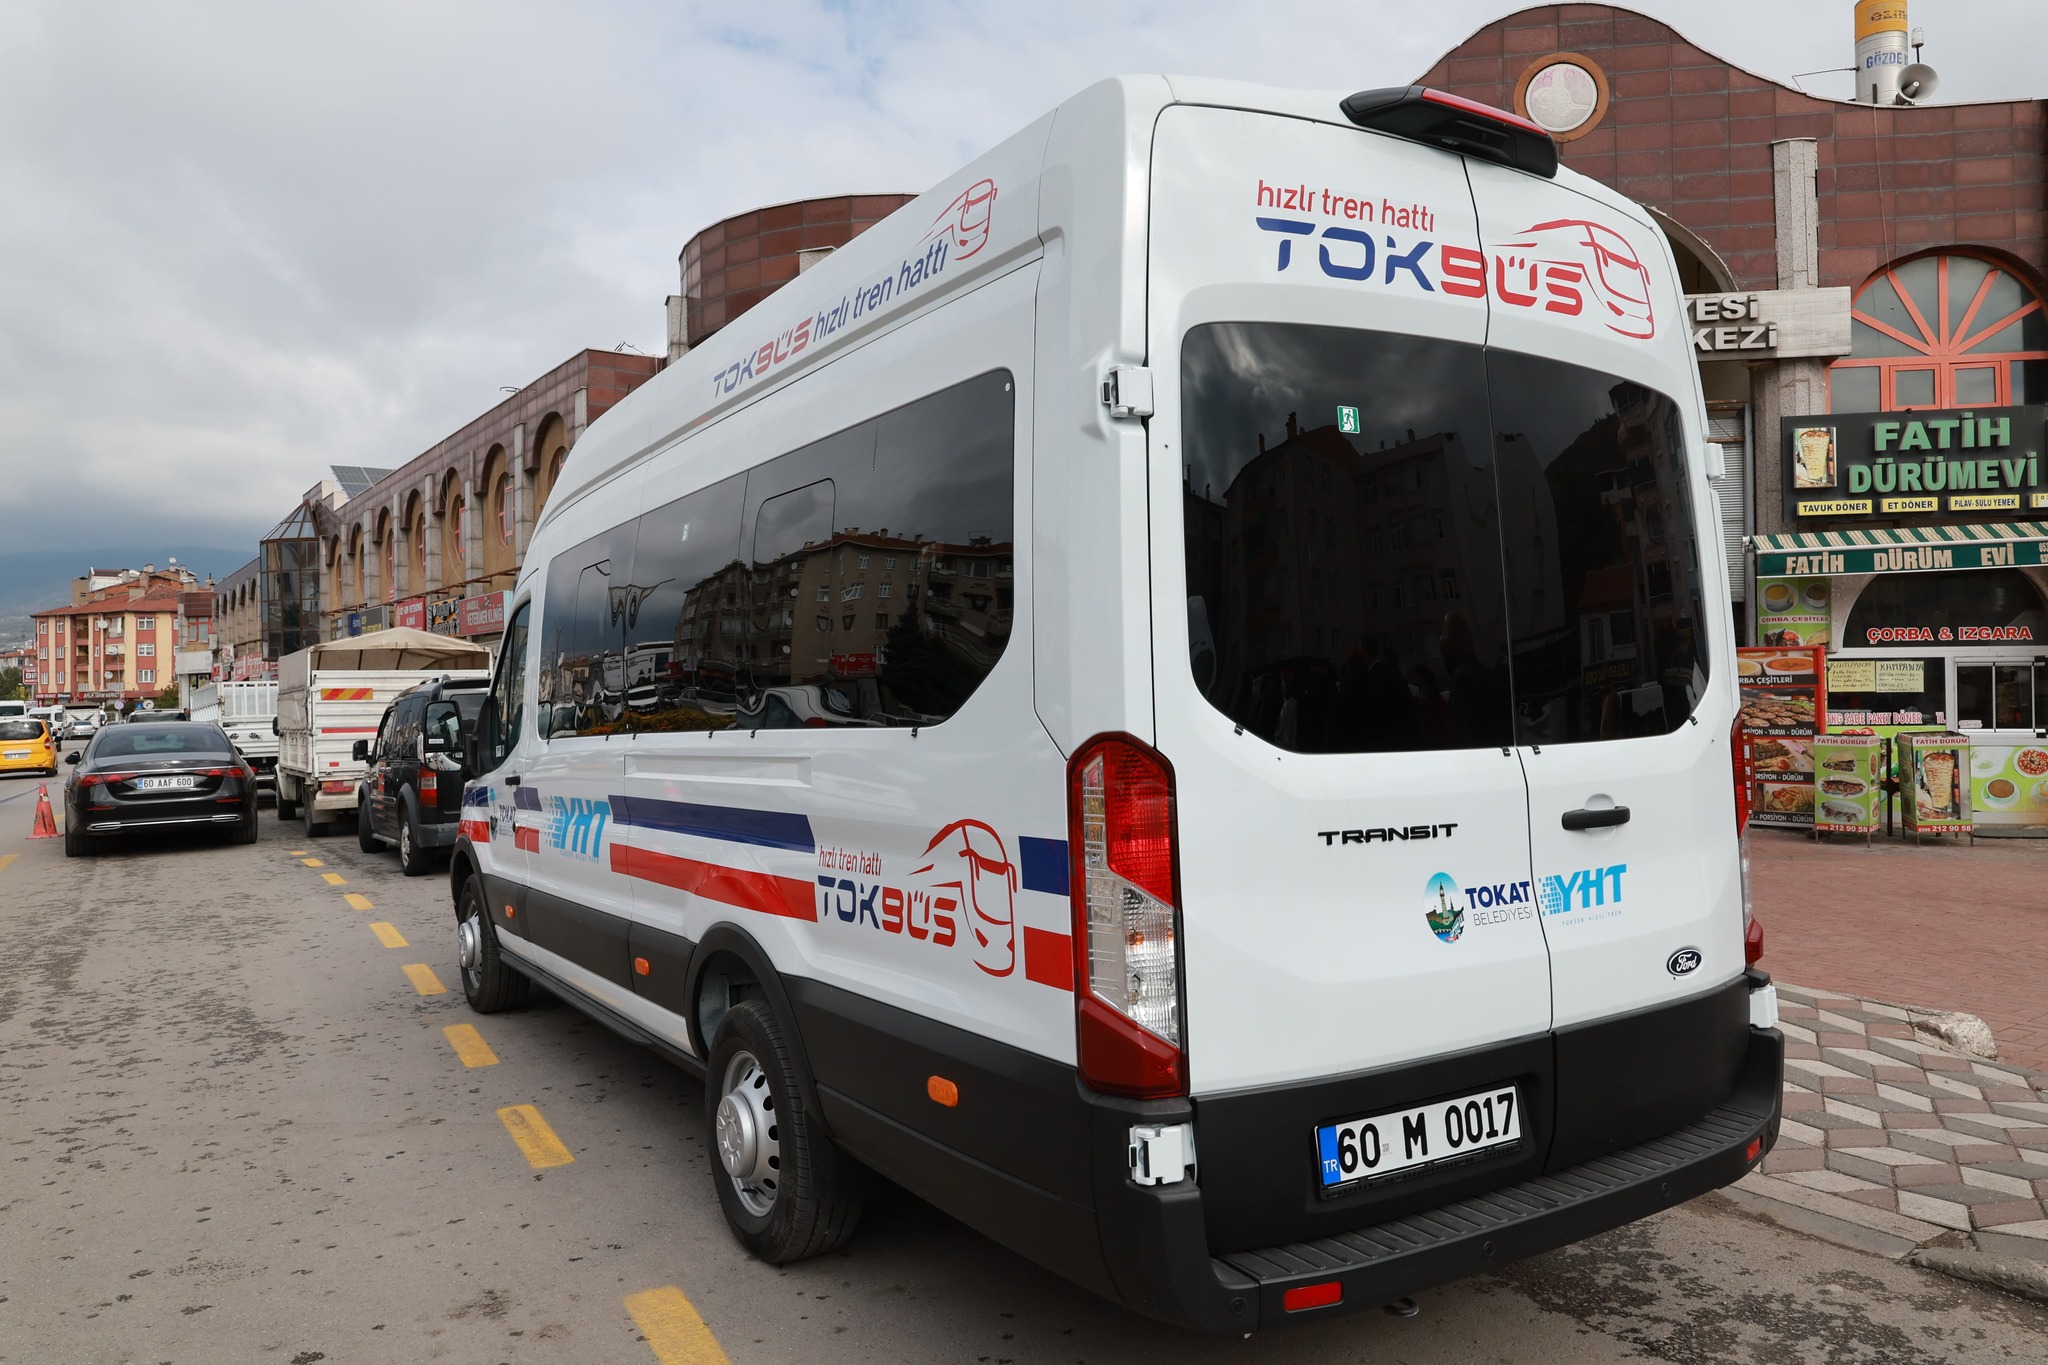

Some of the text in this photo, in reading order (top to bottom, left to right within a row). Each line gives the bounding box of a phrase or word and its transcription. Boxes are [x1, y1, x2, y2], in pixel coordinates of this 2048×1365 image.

[1866, 50, 1902, 69] GÖZDE
[1256, 179, 1435, 233] hızlı tren hattı
[1255, 216, 1584, 318] TOKBÜS
[813, 297, 850, 343] hızlı
[852, 276, 893, 320] tren
[896, 239, 949, 297] hattı
[1873, 411, 2011, 452] FATİH
[1848, 451, 2039, 494] DÜRÜMEVİ
[1803, 501, 1868, 513] TAVUK DÖNER
[1887, 500, 1933, 511] ET DÖNER
[1993, 498, 2016, 507] YEMEK
[1785, 551, 1845, 575] FATİH
[1873, 547, 1953, 572] DÜRÜM
[1980, 542, 2016, 566] EVİ
[1866, 626, 2033, 645] ÇORBA & IZGARA
[1879, 662, 1924, 671] KAMPANYA
[1756, 675, 1793, 685] ÇEŞİTLERİ
[1844, 711, 1866, 725] SADE
[1866, 711, 1892, 725] PAKET
[1892, 708, 1923, 725] DÖNER
[1790, 727, 1813, 736] DÜRÜM
[1817, 737, 1838, 745] FATİH
[1840, 737, 1868, 745] DÜRÜM
[1916, 736, 1968, 745] FATİH DÜRÜM
[143, 777, 192, 788] 60 AAF 600
[1782, 772, 1805, 781] DÜRÜM
[556, 795, 611, 859] YHT
[1317, 823, 1458, 847] TRANSIT
[1829, 823, 1845, 832] 212
[1857, 825, 1868, 833] 58
[1961, 824, 1971, 832] 58
[818, 846, 882, 876] hızlı tren hattı
[1464, 880, 1530, 910] TOKAT
[1552, 863, 1627, 913] YHT
[817, 875, 958, 948] TOKBÜS
[1472, 905, 1534, 927] BELEDİYESİ
[1676, 952, 1698, 974] Ford
[1337, 1091, 1514, 1174] 60 M 0017
[1323, 1158, 1339, 1174] TR
